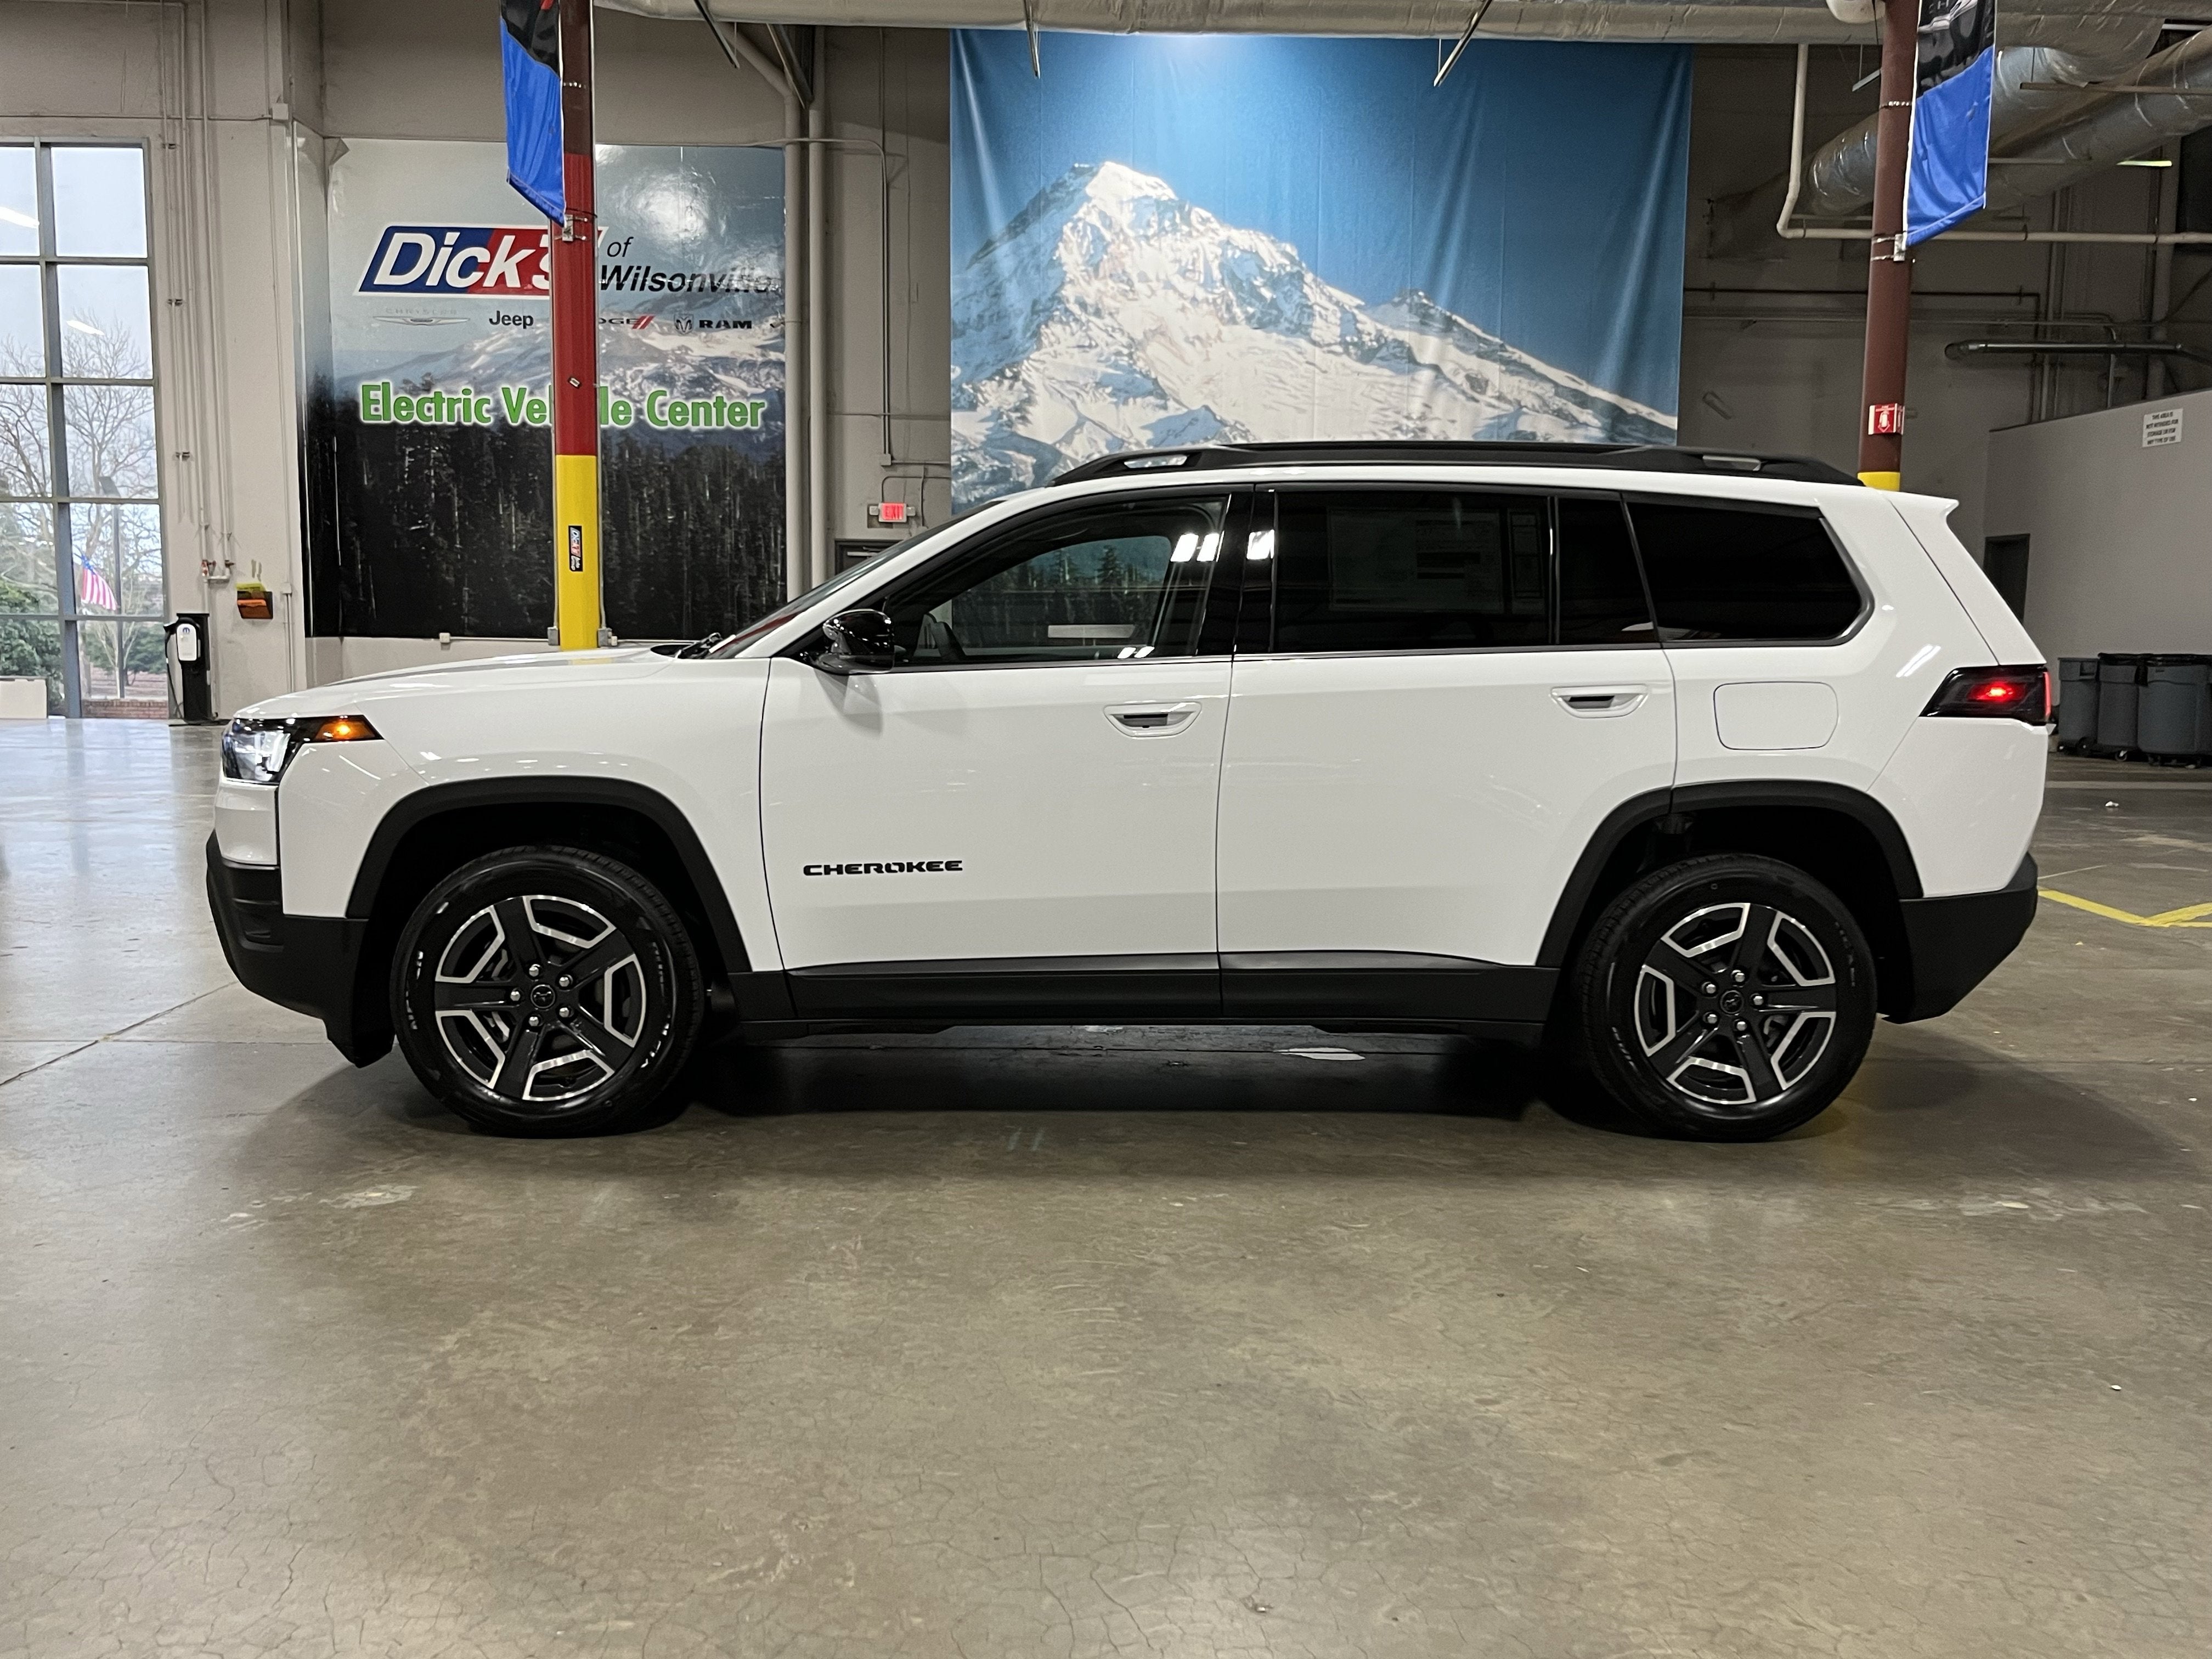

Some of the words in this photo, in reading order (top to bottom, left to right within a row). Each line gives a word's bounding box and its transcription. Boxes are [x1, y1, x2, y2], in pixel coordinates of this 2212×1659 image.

[607, 236, 634, 257] of
[601, 264, 769, 293] Wilsonve
[489, 311, 534, 329] Jeep
[699, 319, 752, 329] RAM
[362, 382, 492, 424] Electric
[501, 386, 632, 426] Vele
[647, 390, 766, 427] Center
[885, 505, 904, 518] EXIT
[803, 860, 963, 876] CHEROKEE
